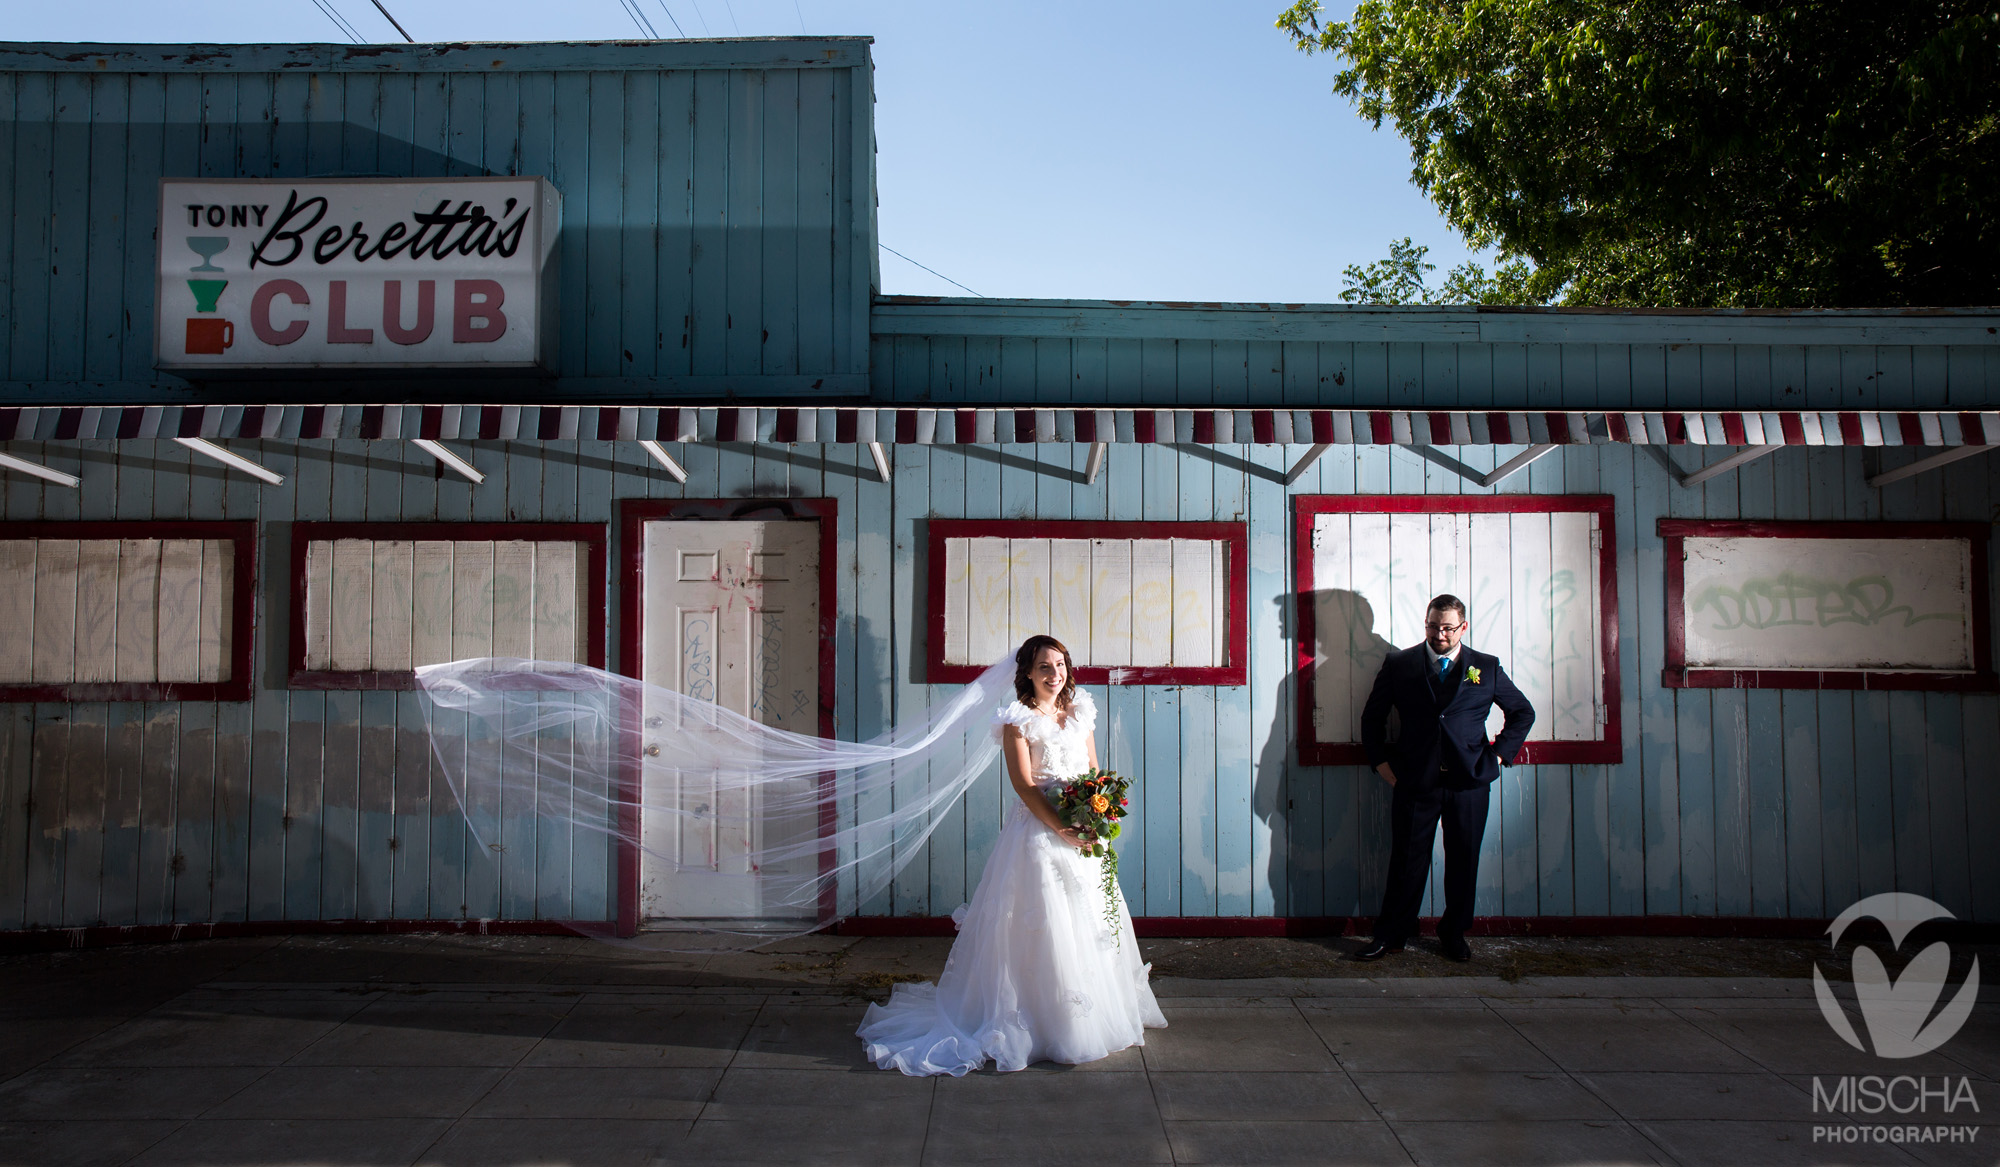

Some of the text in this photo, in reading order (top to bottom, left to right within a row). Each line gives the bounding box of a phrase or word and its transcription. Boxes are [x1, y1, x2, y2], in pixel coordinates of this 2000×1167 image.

[187, 188, 532, 270] TONY Beretta's
[250, 278, 508, 346] CLUB
